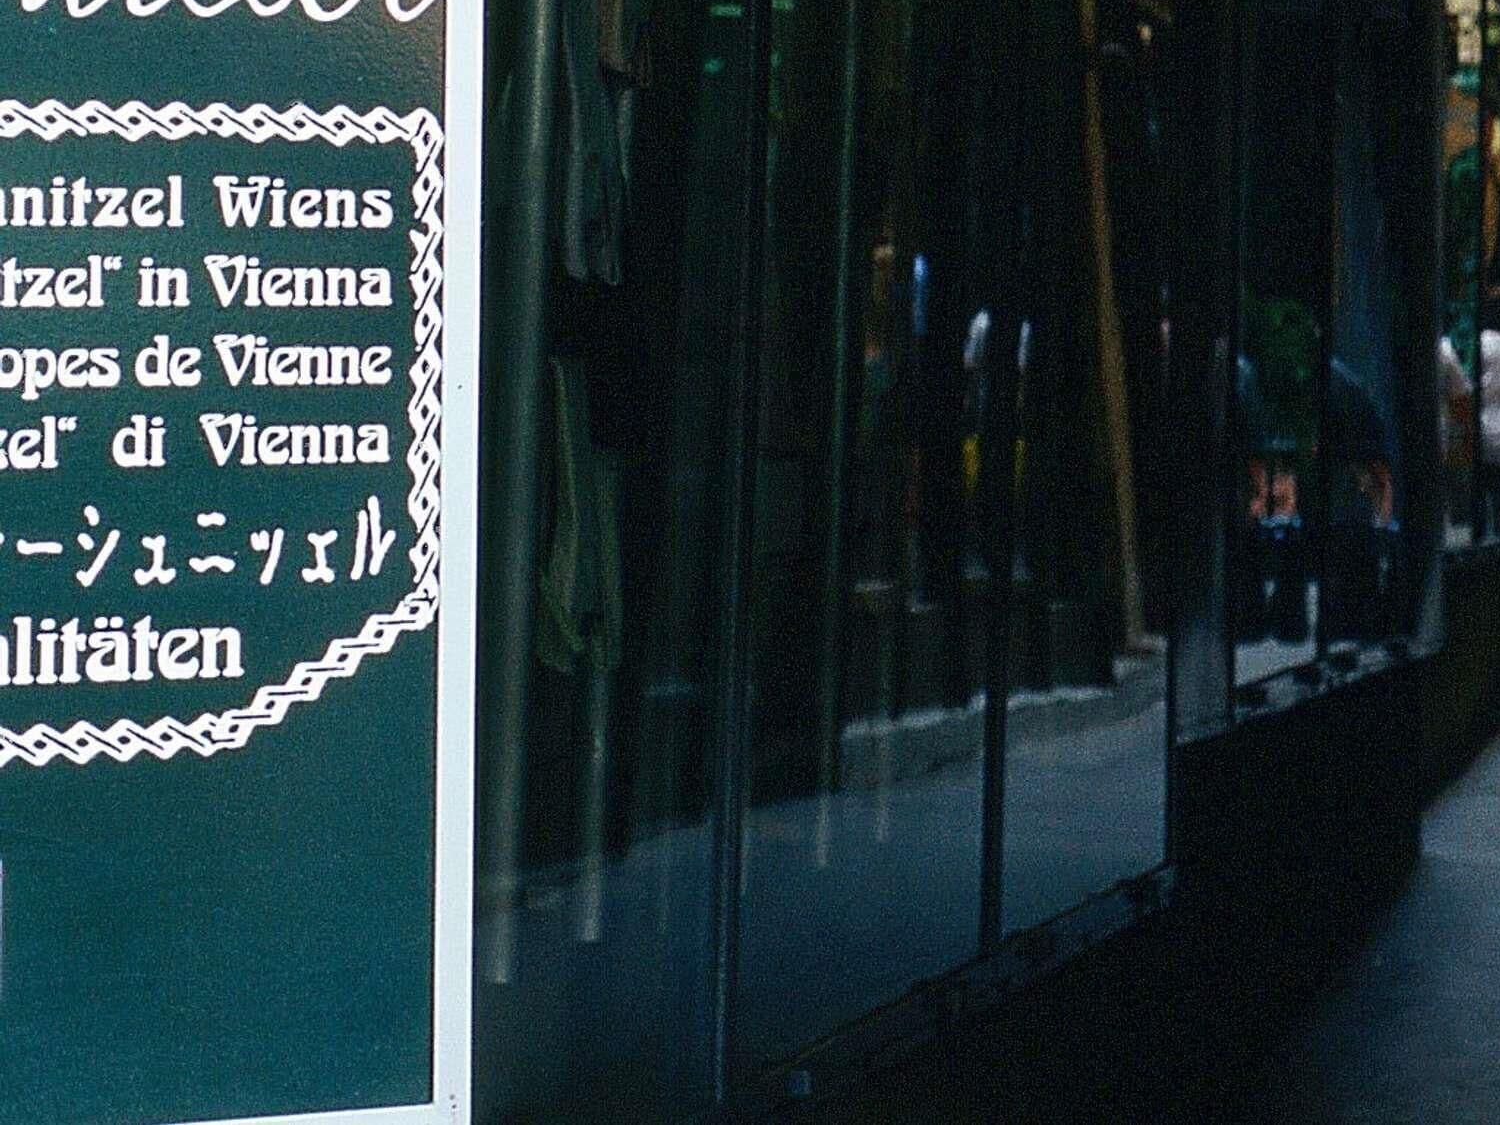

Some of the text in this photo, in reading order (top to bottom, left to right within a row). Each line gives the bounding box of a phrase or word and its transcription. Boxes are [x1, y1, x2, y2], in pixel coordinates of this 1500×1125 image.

[0, 176, 394, 228] nitzel Wiens
[138, 257, 191, 307] in
[204, 255, 393, 308] Vienna
[0, 333, 392, 401] opes de Vienne
[113, 415, 166, 467] di
[199, 413, 391, 466] Vienna
[0, 615, 245, 685] litäten
